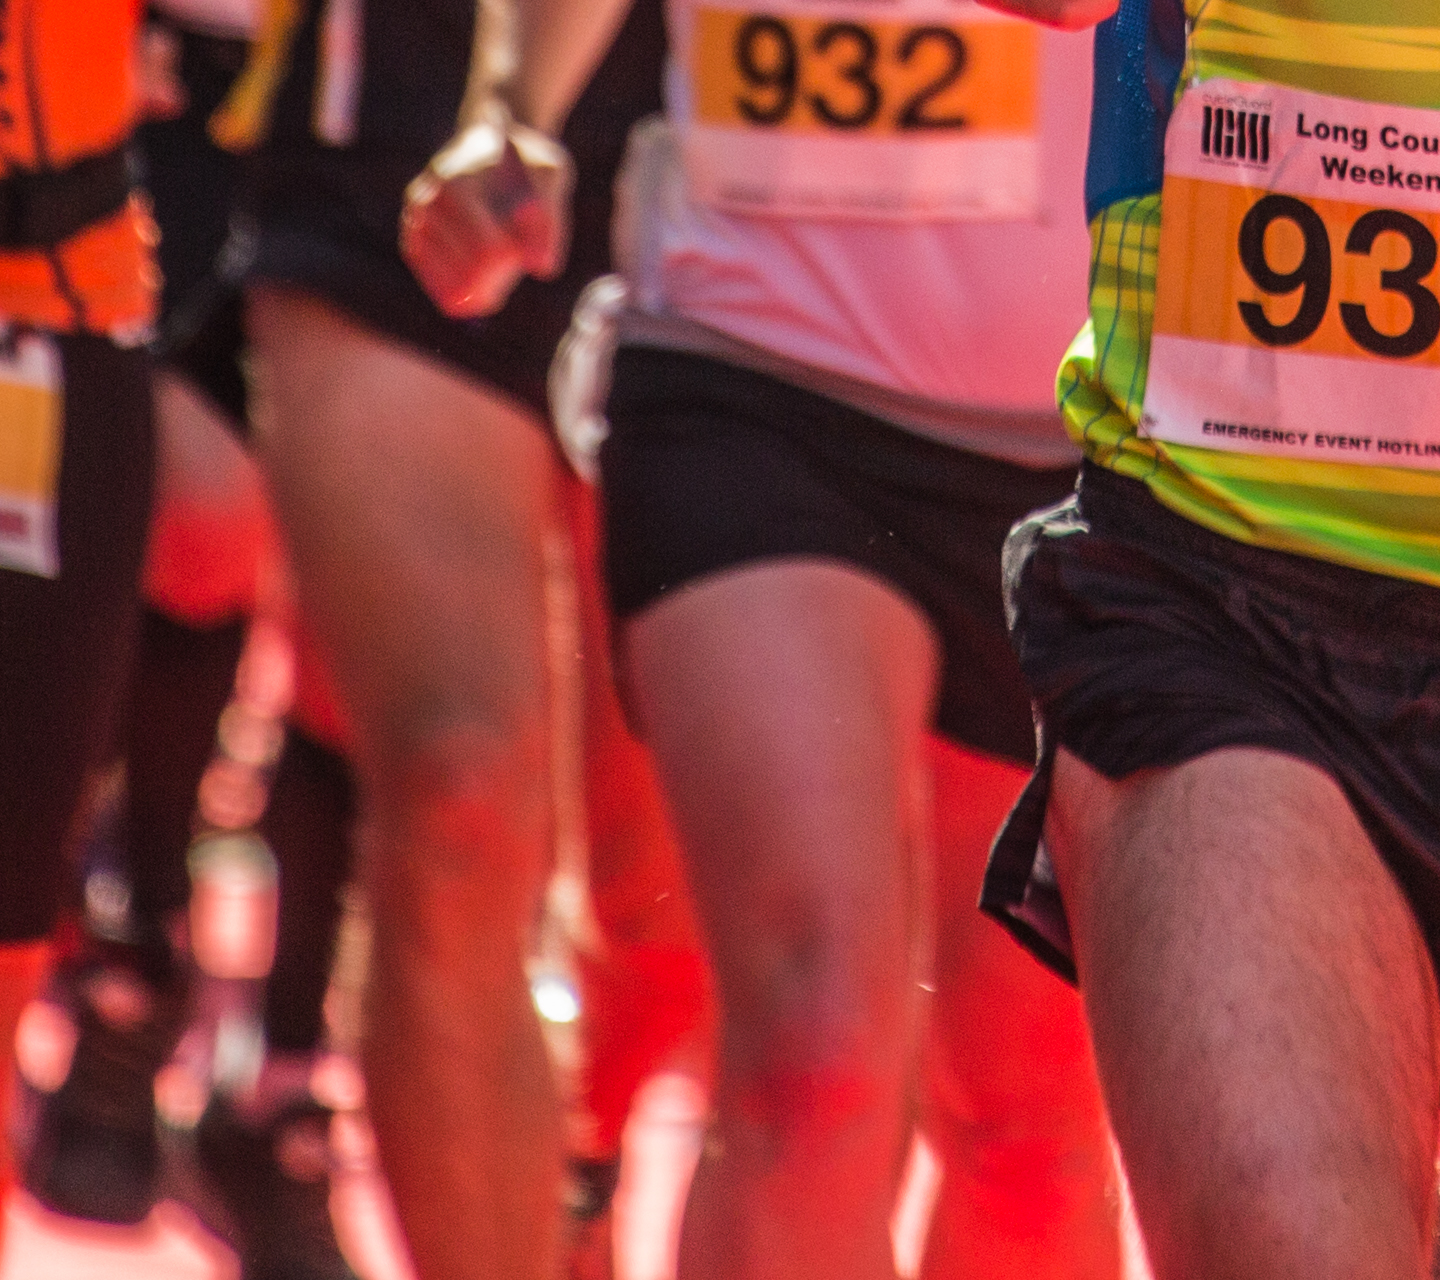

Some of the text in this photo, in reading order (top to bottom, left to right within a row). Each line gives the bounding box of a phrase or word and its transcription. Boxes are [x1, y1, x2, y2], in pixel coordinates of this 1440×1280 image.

[734, 15, 969, 131] 932
[1296, 112, 1368, 152] Long
[1201, 421, 1309, 447] EMERGENCY
[1314, 433, 1372, 453] EVENT
